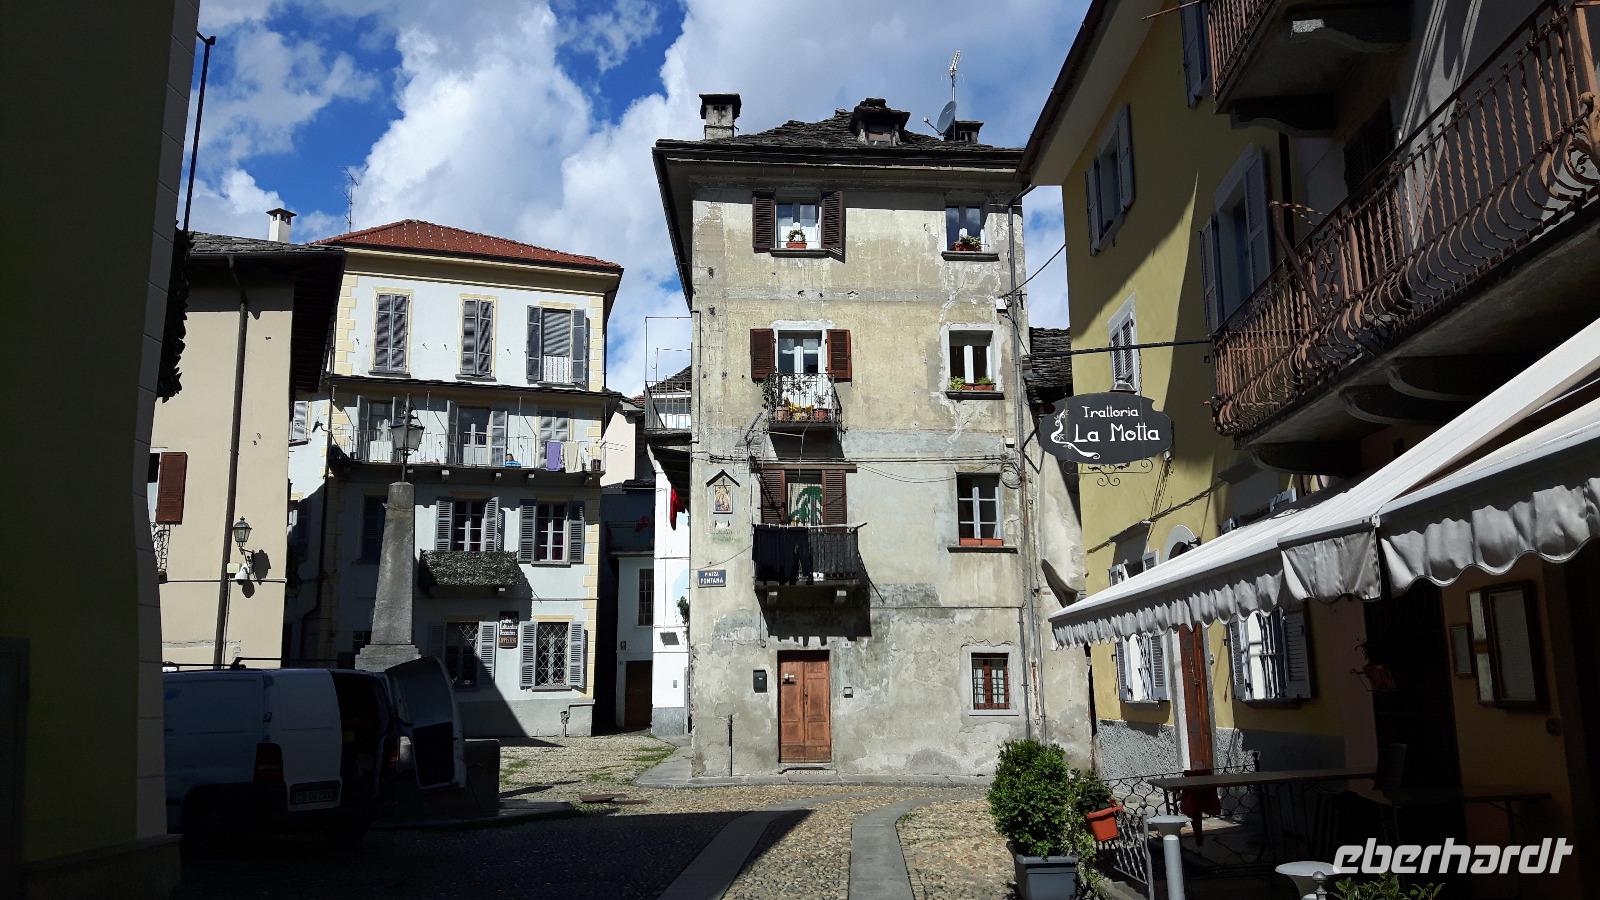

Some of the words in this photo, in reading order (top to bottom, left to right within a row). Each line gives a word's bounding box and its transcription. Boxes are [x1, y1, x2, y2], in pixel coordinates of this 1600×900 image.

[1081, 404, 1140, 418] Trattoria
[1073, 423, 1101, 443] La
[1109, 421, 1161, 442] Motta
